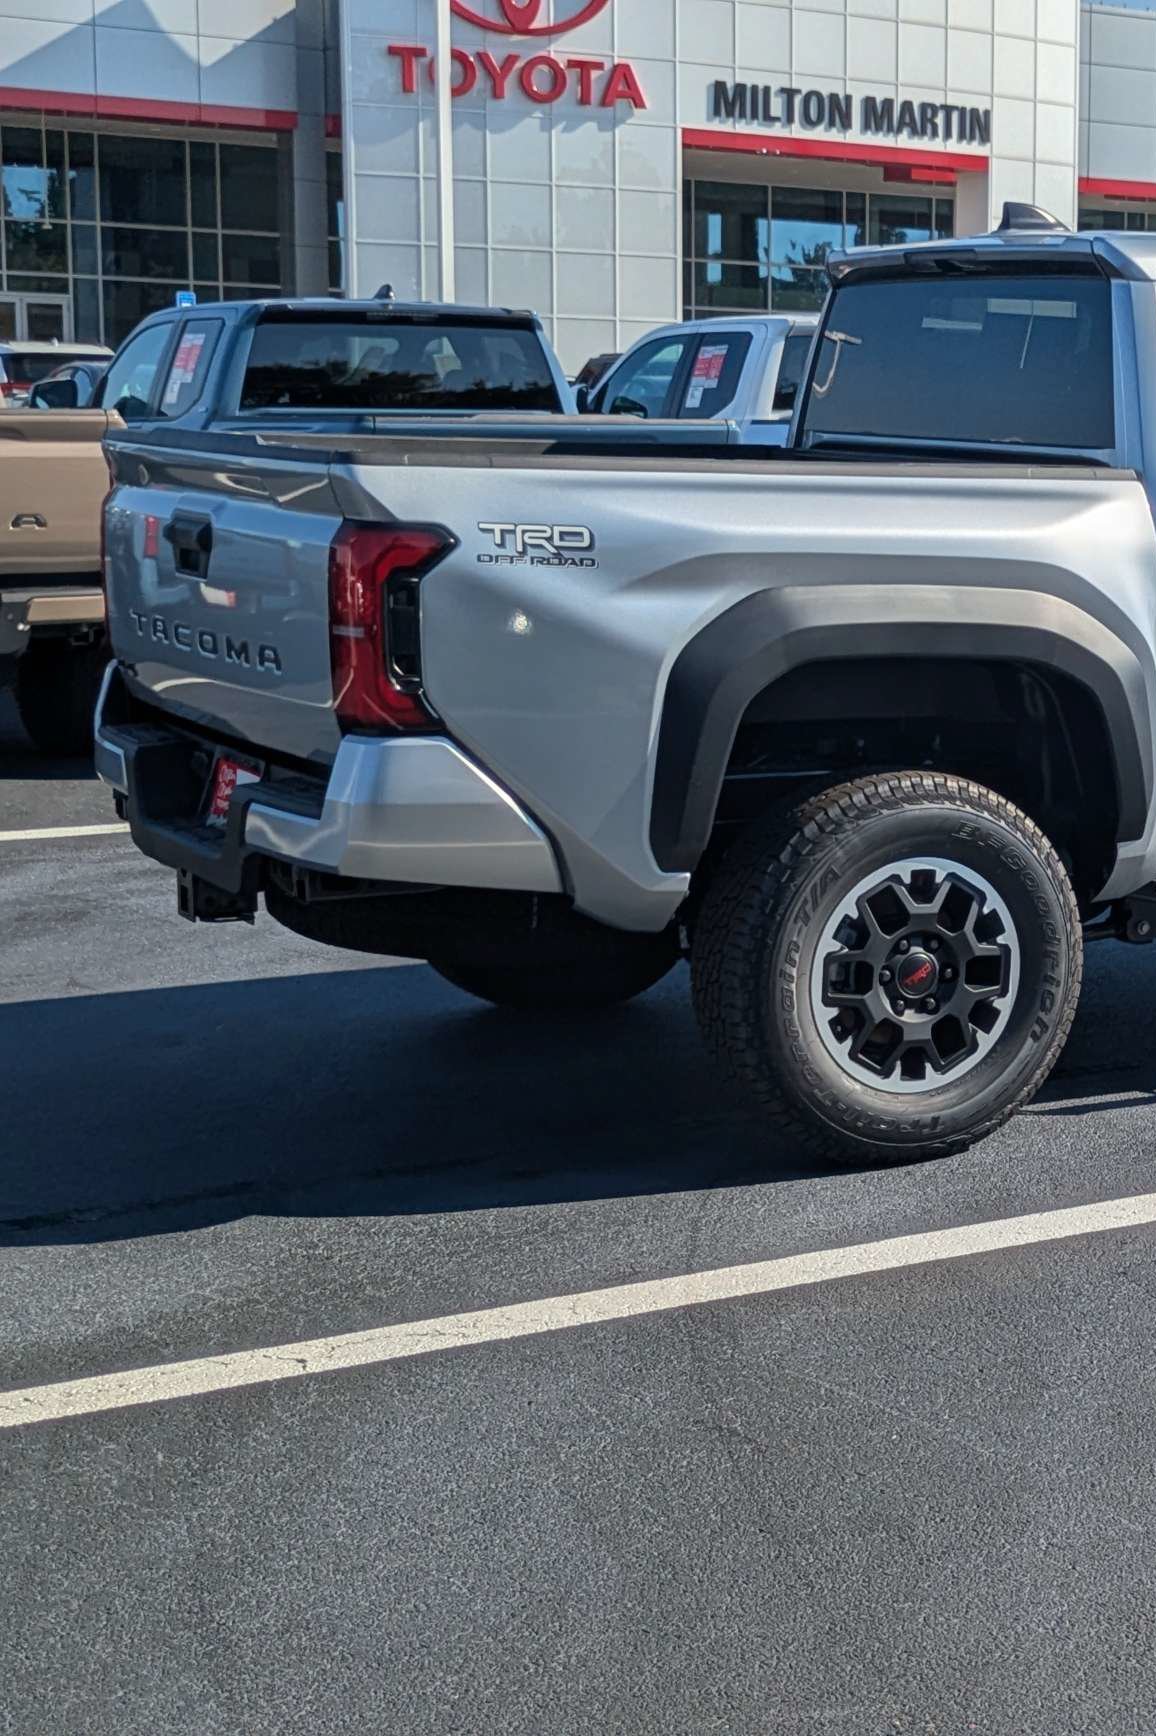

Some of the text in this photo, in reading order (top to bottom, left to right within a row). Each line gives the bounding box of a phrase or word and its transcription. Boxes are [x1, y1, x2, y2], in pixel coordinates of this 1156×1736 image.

[387, 44, 647, 110] TOYOTA
[713, 80, 992, 145] MILTON MARTIN
[476, 554, 599, 569] OFF ROAD
[478, 521, 594, 554] TRD
[128, 608, 283, 676] TACOMA
